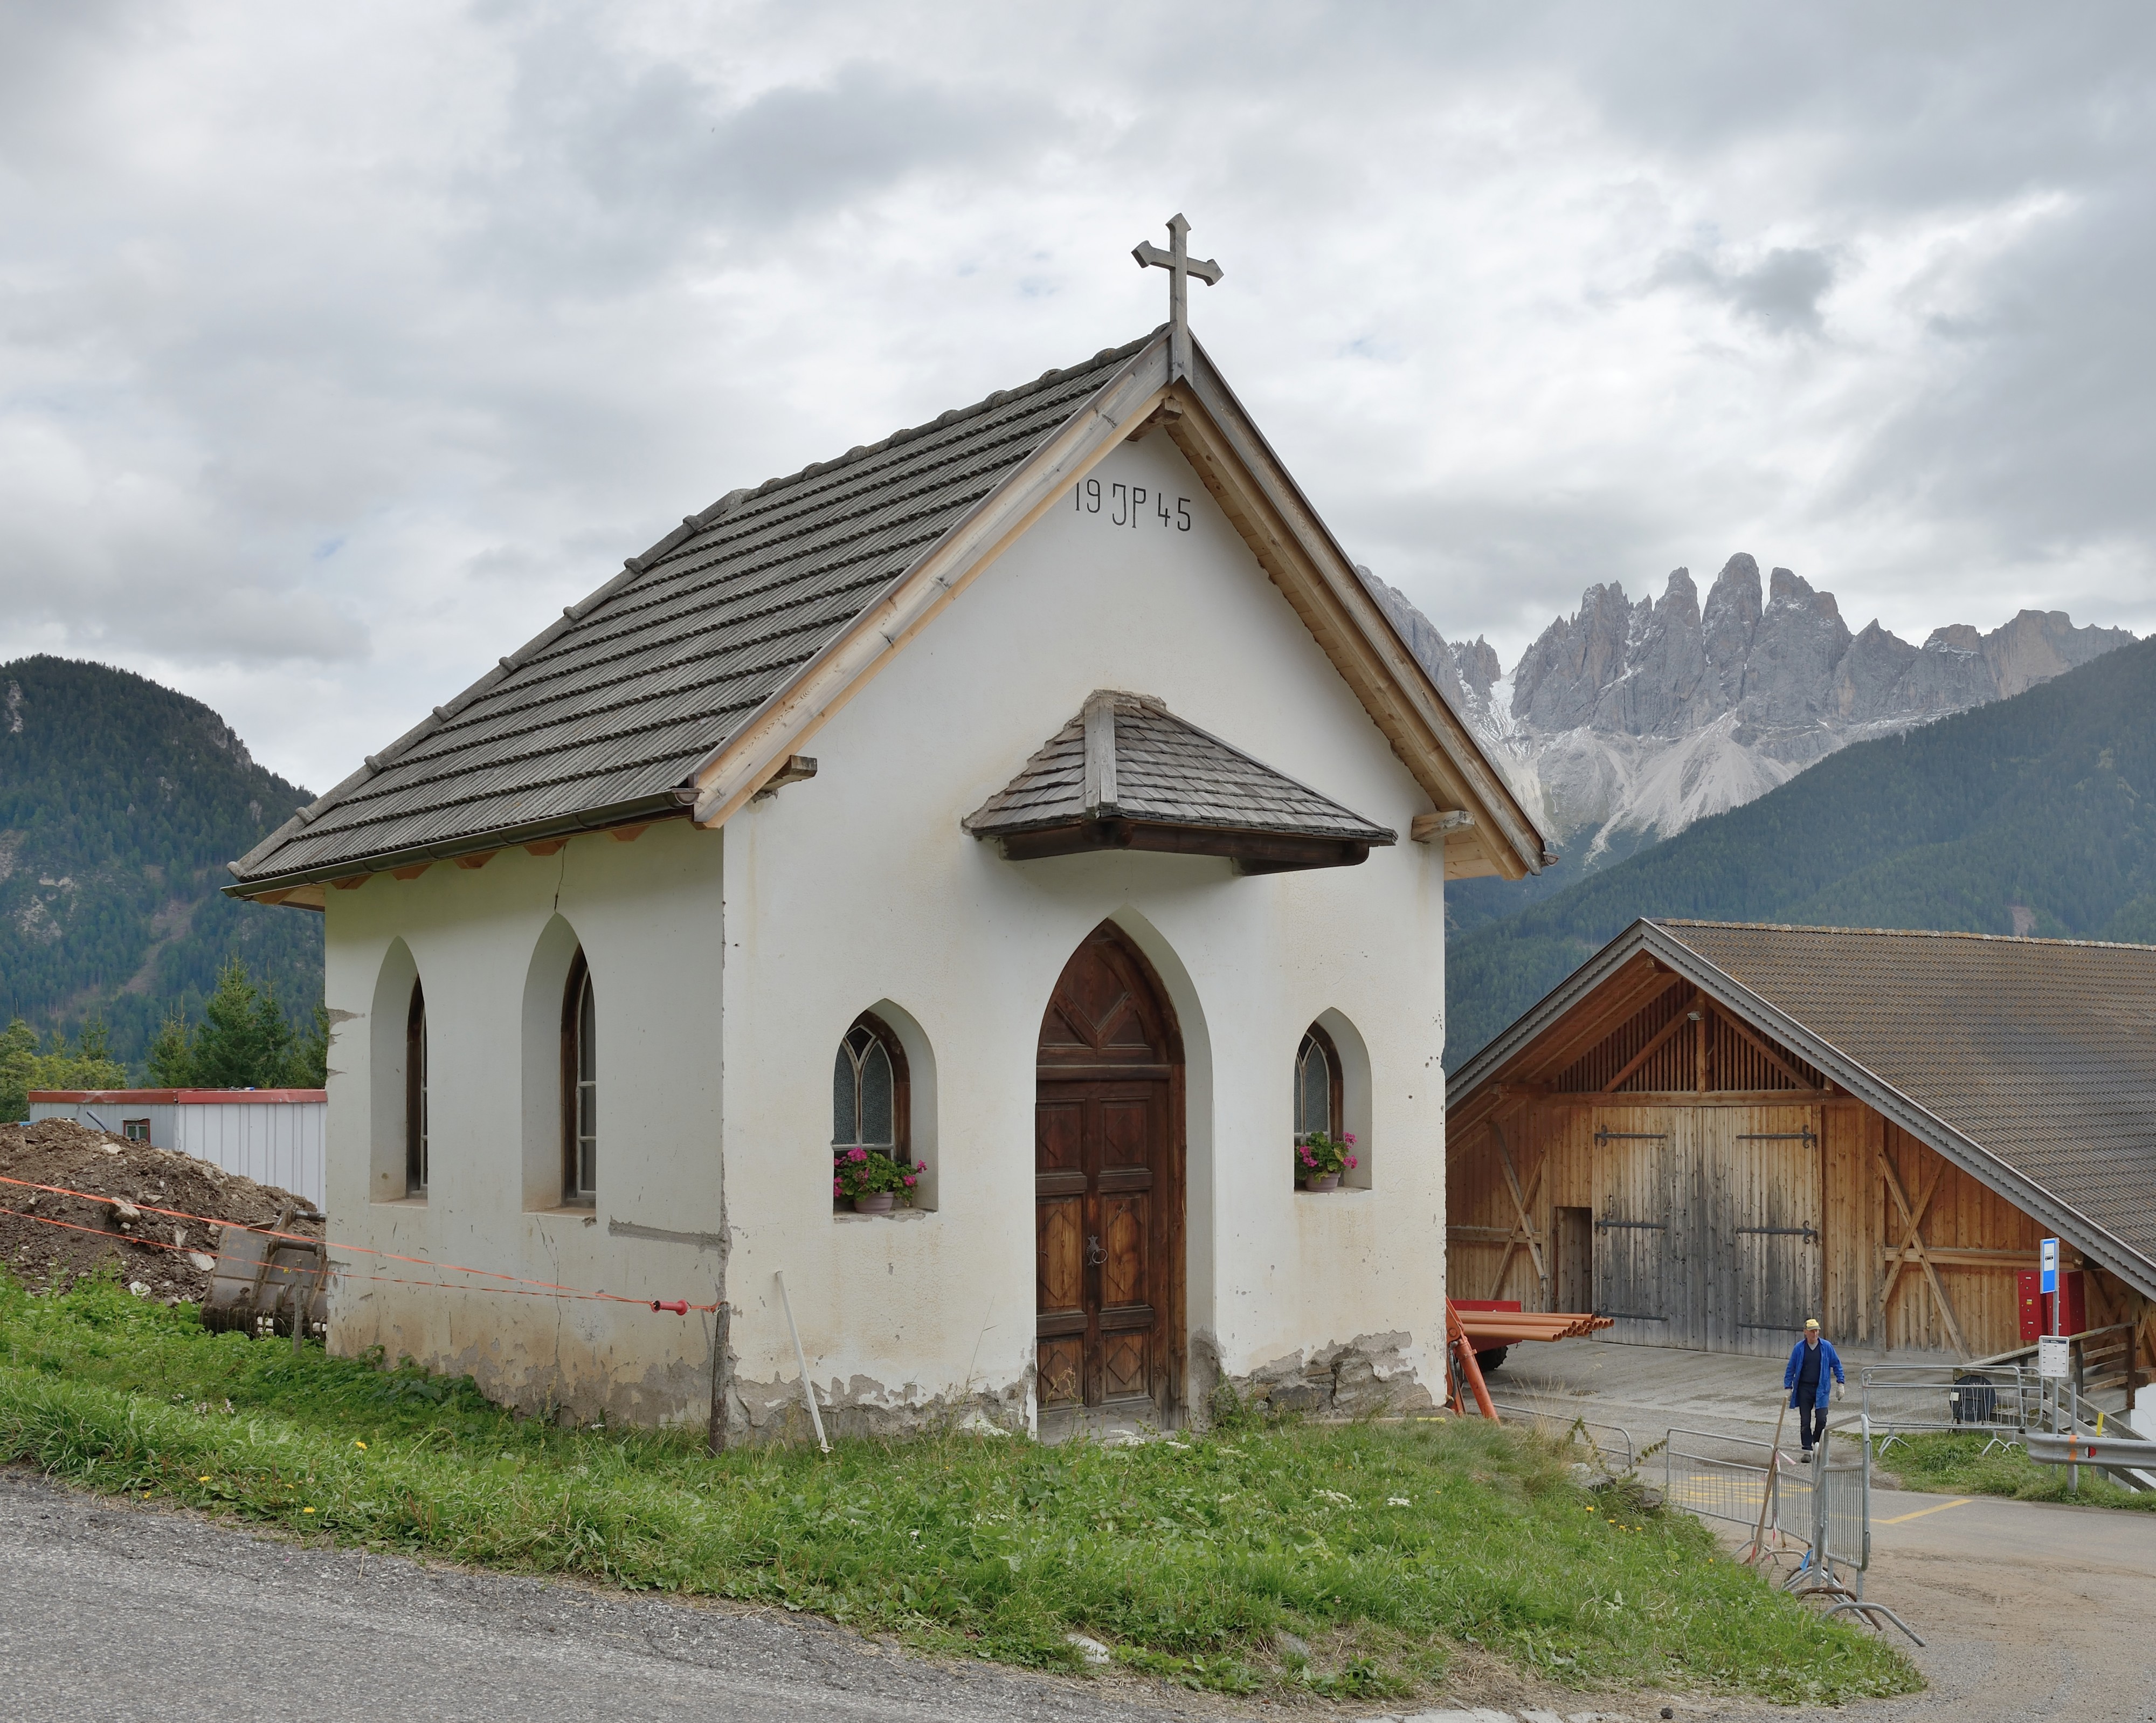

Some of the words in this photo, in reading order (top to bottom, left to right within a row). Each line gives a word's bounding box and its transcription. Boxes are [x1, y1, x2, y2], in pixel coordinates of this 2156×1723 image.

[1076, 479, 1100, 513] 19
[1112, 483, 1146, 528] JP
[1158, 493, 1191, 532] 45
